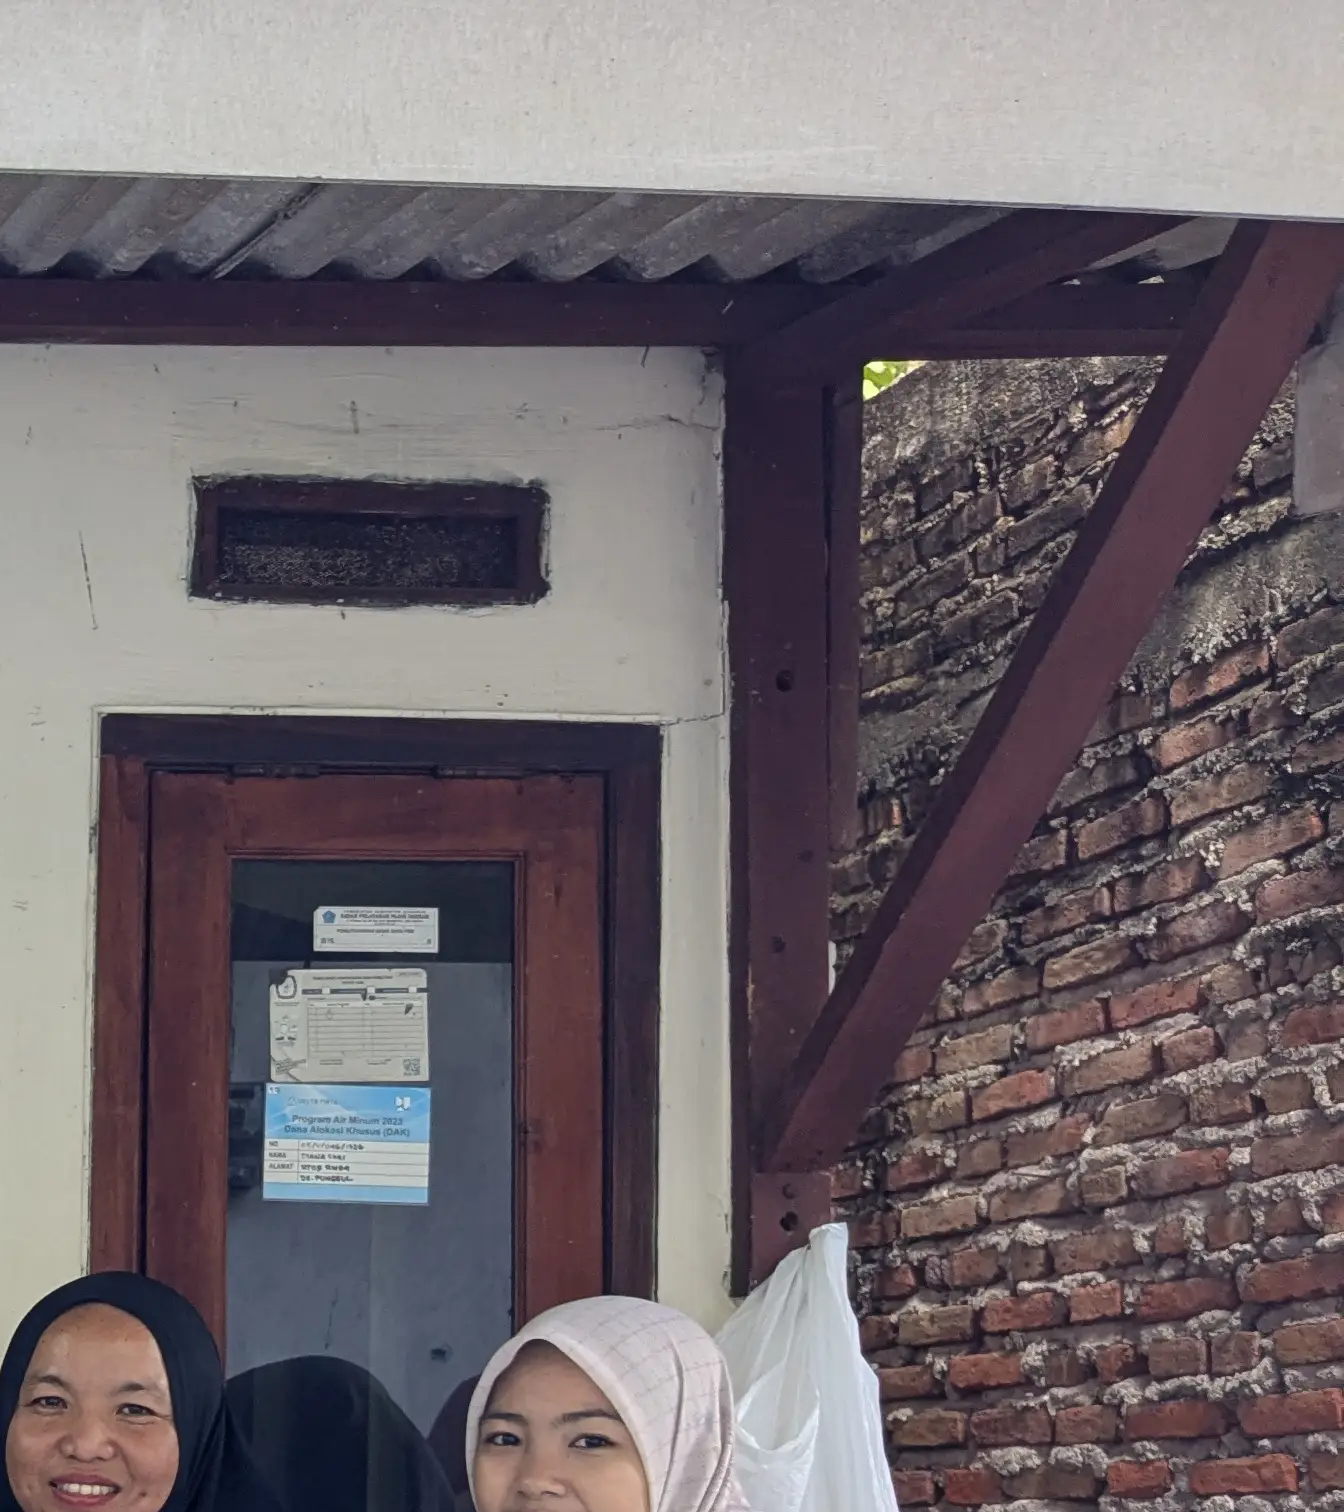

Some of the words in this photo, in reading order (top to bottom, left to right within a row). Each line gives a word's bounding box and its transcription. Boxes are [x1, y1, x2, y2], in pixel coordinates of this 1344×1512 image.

[292, 1115, 331, 1125] Program
[333, 1116, 346, 1124] Air
[348, 1116, 379, 1125] Minum
[284, 1126, 308, 1134] Dana
[310, 1126, 344, 1135] Alokasi
[346, 1127, 381, 1136] Khusus
[383, 1127, 410, 1138] (DAK)
